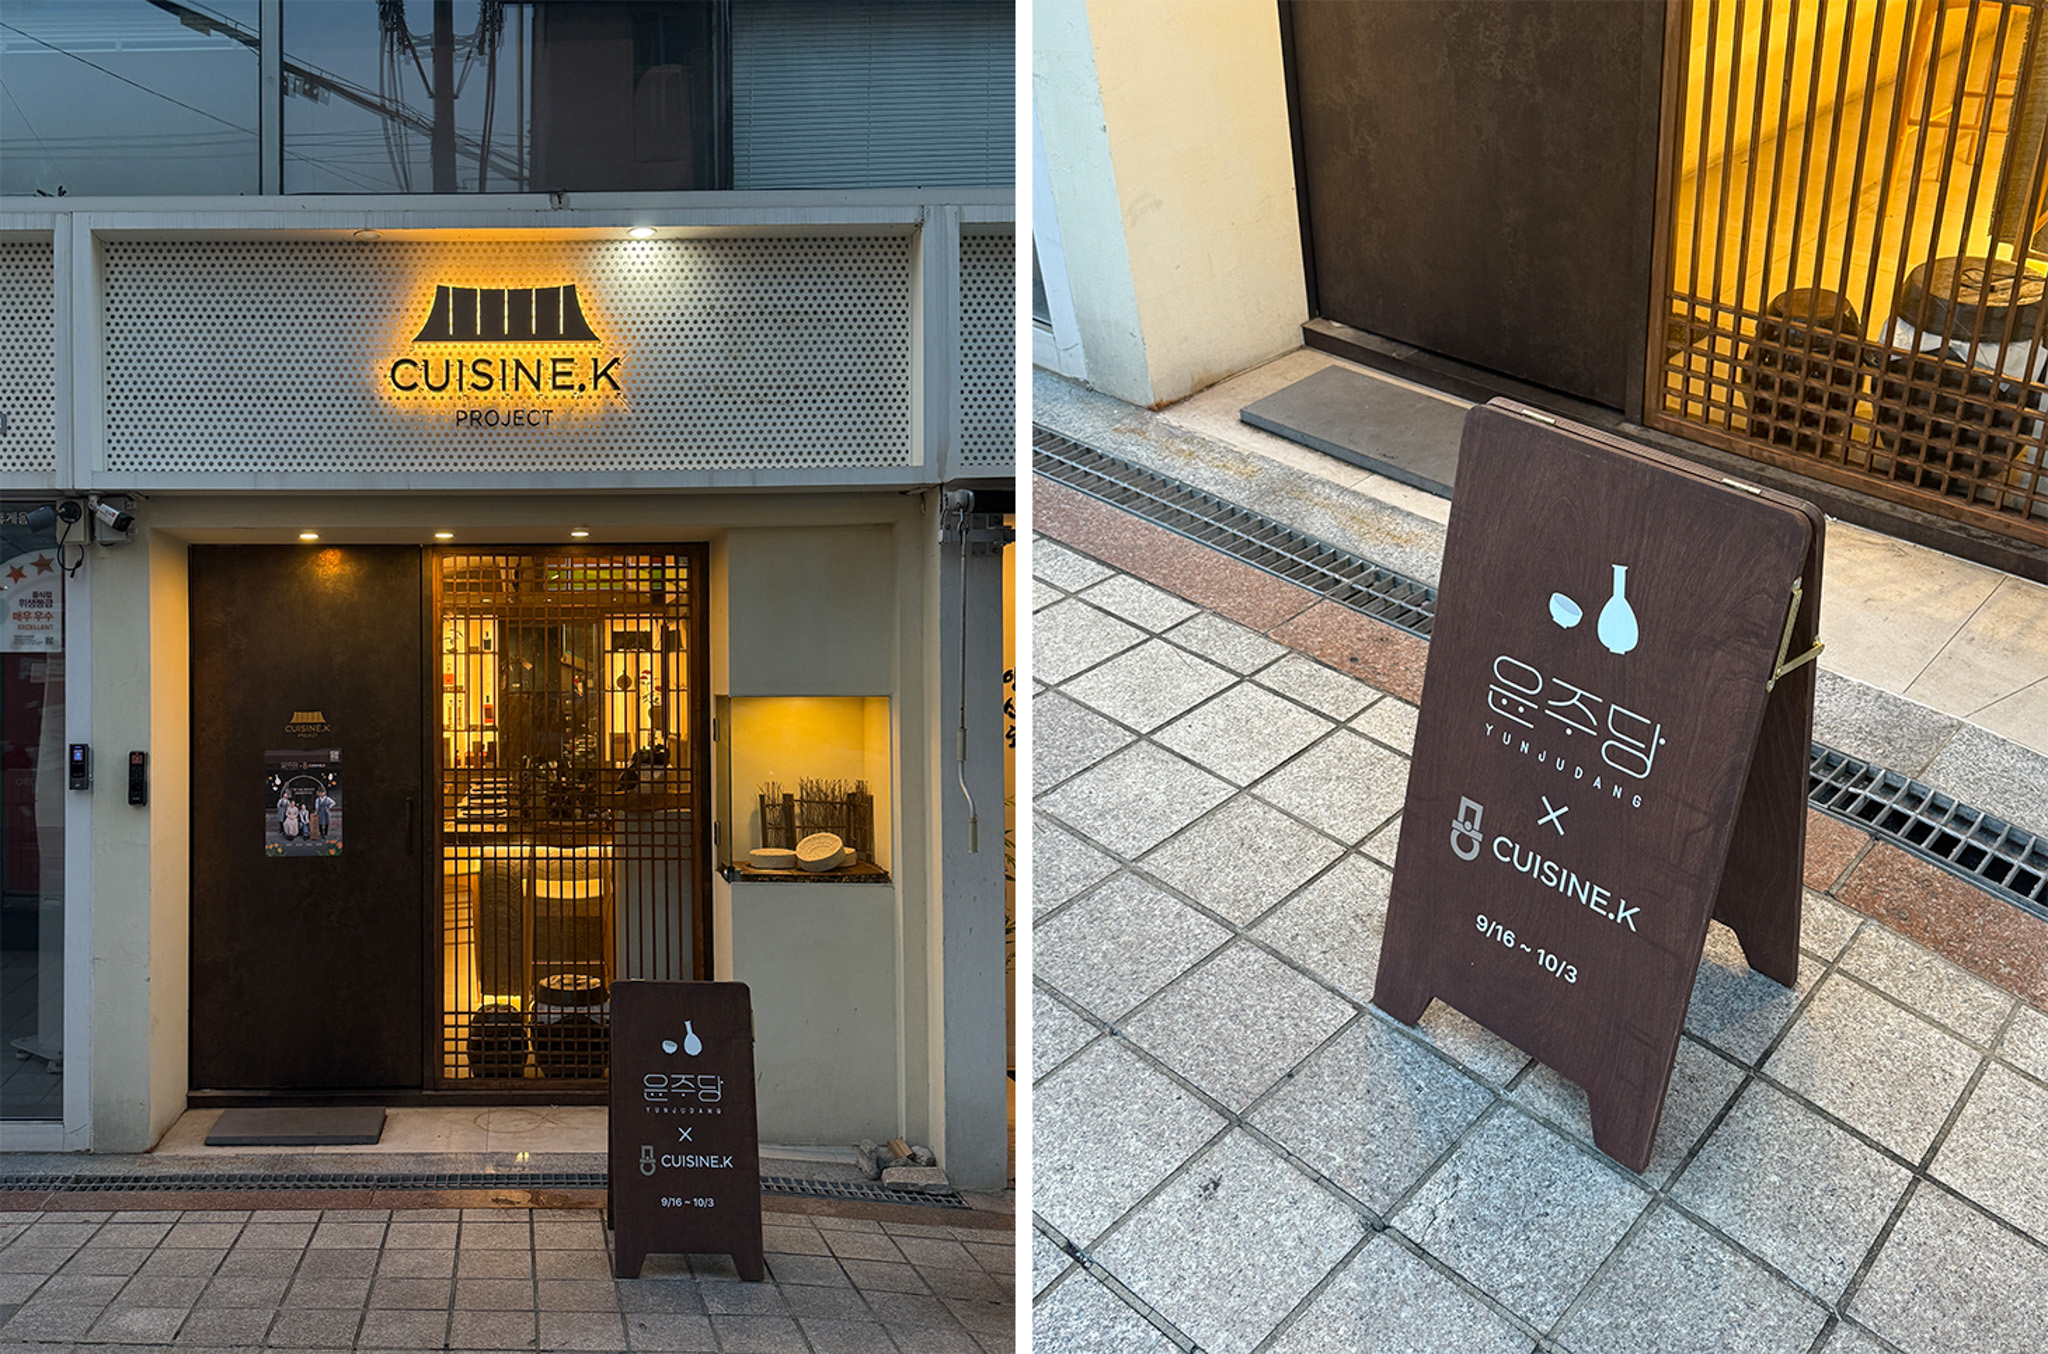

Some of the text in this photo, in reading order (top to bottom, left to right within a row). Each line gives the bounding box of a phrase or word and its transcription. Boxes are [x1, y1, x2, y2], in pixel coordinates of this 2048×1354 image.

[390, 357, 622, 393] CUISINE.K
[455, 409, 554, 427] PROJECT
[12, 611, 54, 622] 매우 우수
[1488, 655, 1667, 779] 윤주당
[1485, 722, 1643, 809] YUNJUDANG
[1493, 836, 1641, 933] CUISINE.K
[1475, 914, 1516, 949] 9/16
[1536, 948, 1578, 984] 10/3
[643, 1073, 724, 1103] 윤주당
[645, 1106, 722, 1115] YUNJUDANG
[660, 1154, 734, 1169] CUISINE.K
[660, 1197, 683, 1208] 9/16
[693, 1197, 715, 1208] 10/3
